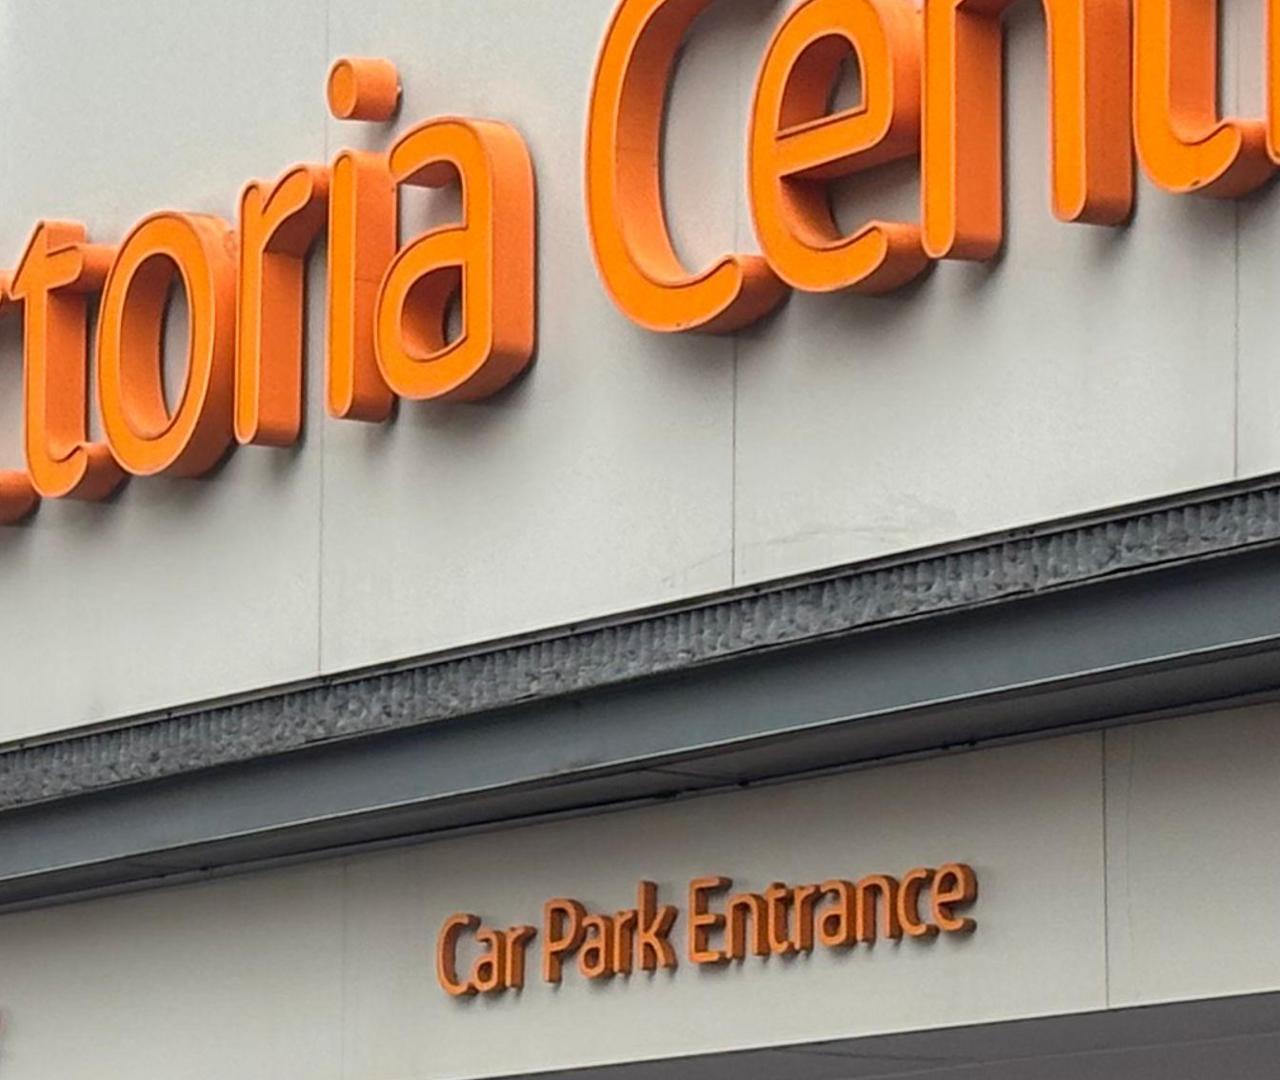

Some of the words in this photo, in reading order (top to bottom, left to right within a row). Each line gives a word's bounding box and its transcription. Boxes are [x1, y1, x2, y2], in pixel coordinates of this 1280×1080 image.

[585, 0, 1280, 335] Cent
[437, 912, 536, 997] Car
[543, 881, 677, 983] Park
[688, 863, 977, 966] Entrance
